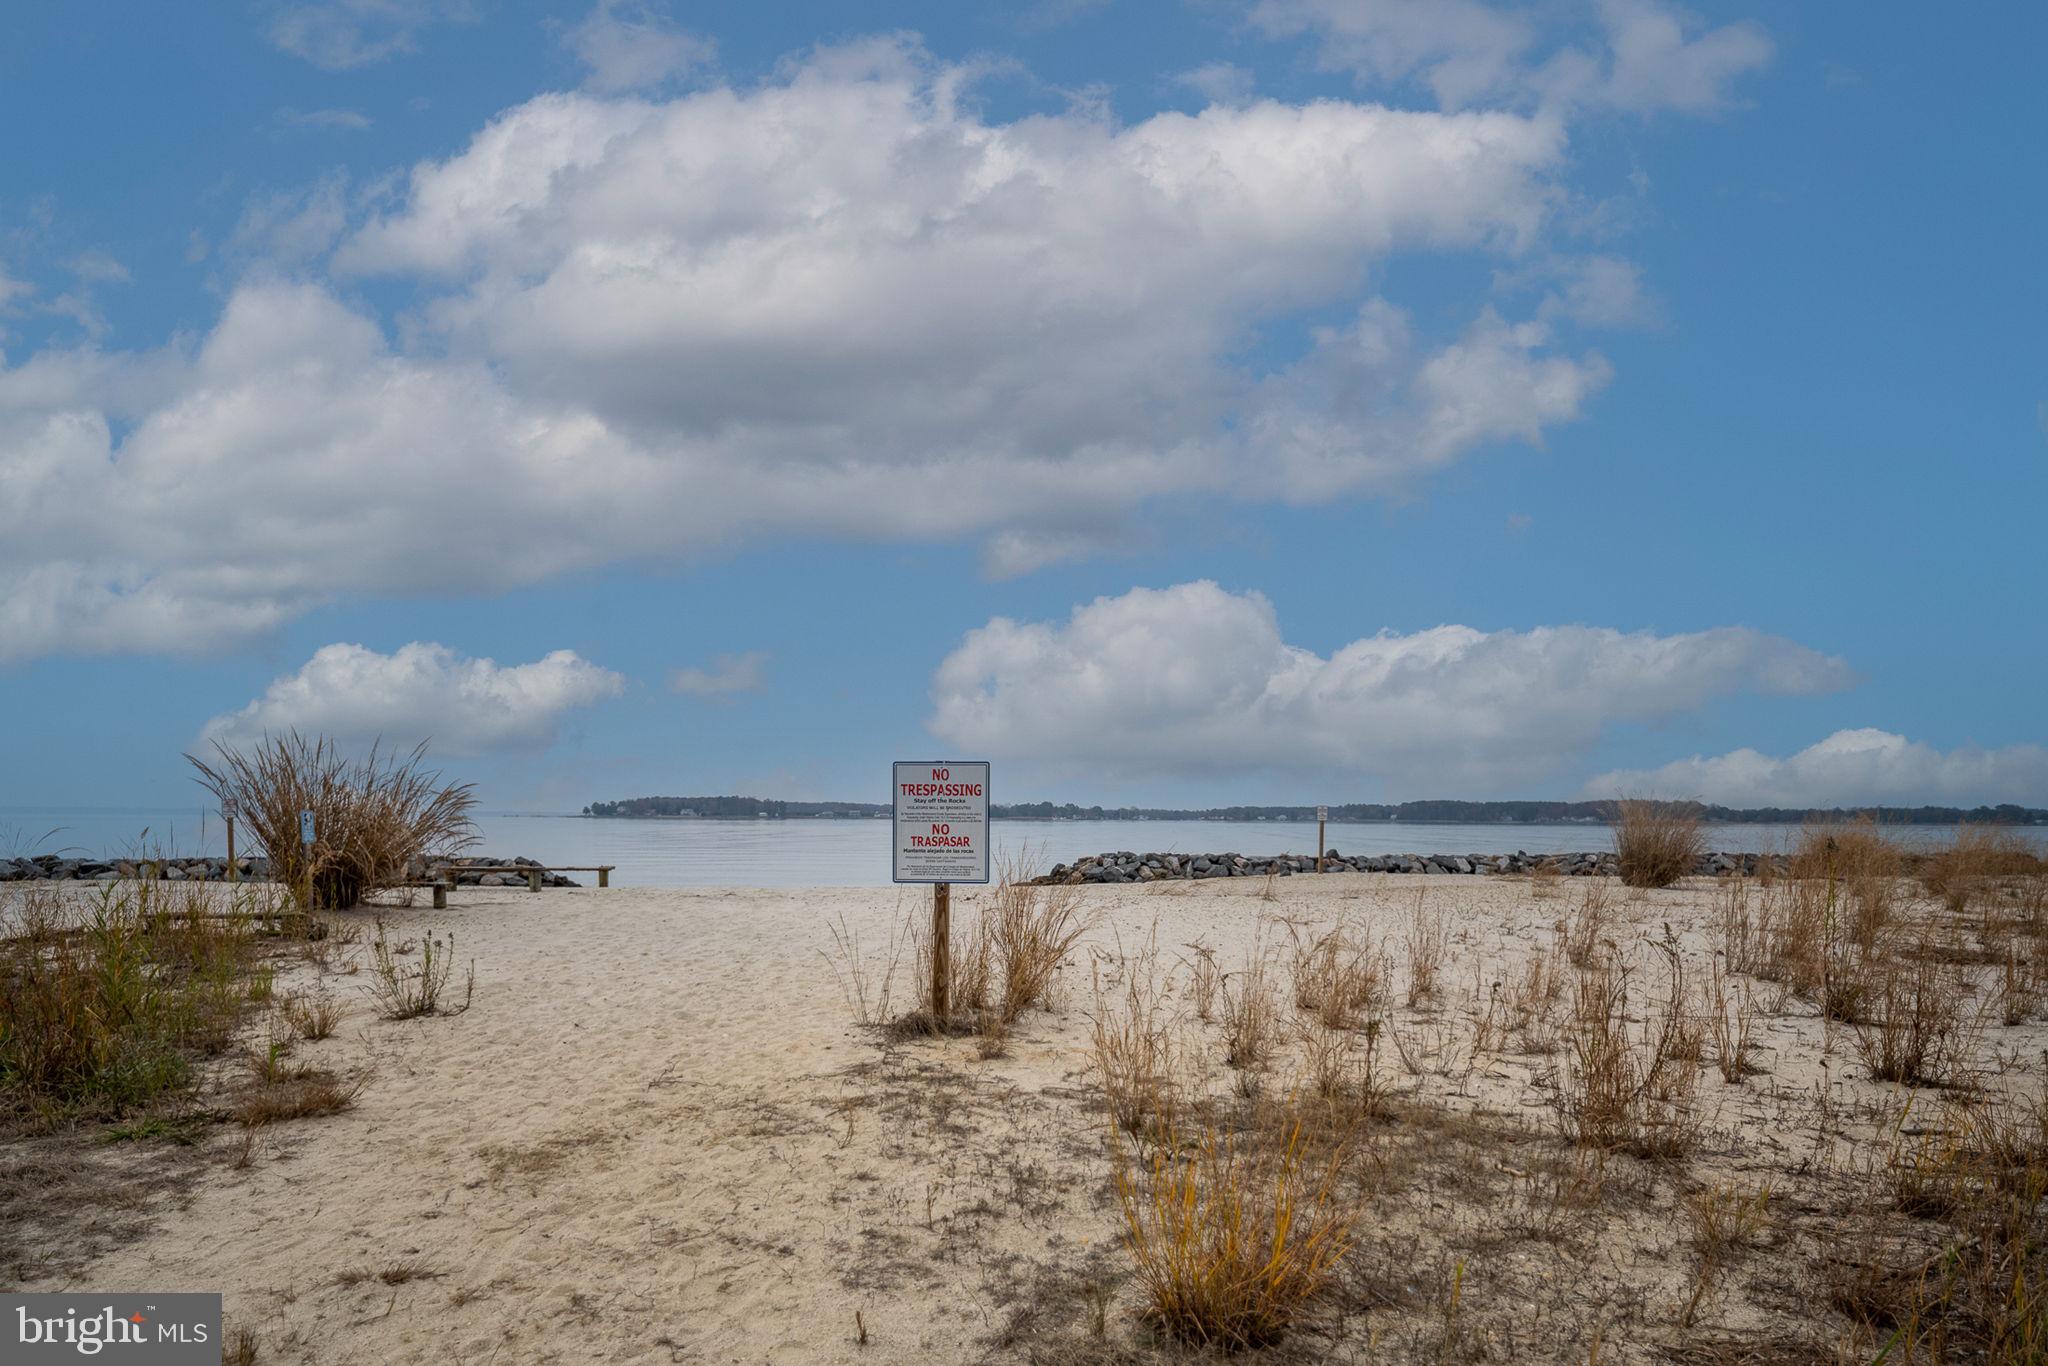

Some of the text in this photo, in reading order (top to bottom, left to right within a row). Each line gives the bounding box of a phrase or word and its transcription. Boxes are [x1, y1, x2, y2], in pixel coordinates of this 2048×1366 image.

[932, 768, 950, 781] NO
[900, 784, 982, 797] TRESPASSING
[931, 823, 950, 835] NO
[910, 836, 970, 847] TRASPASAR
